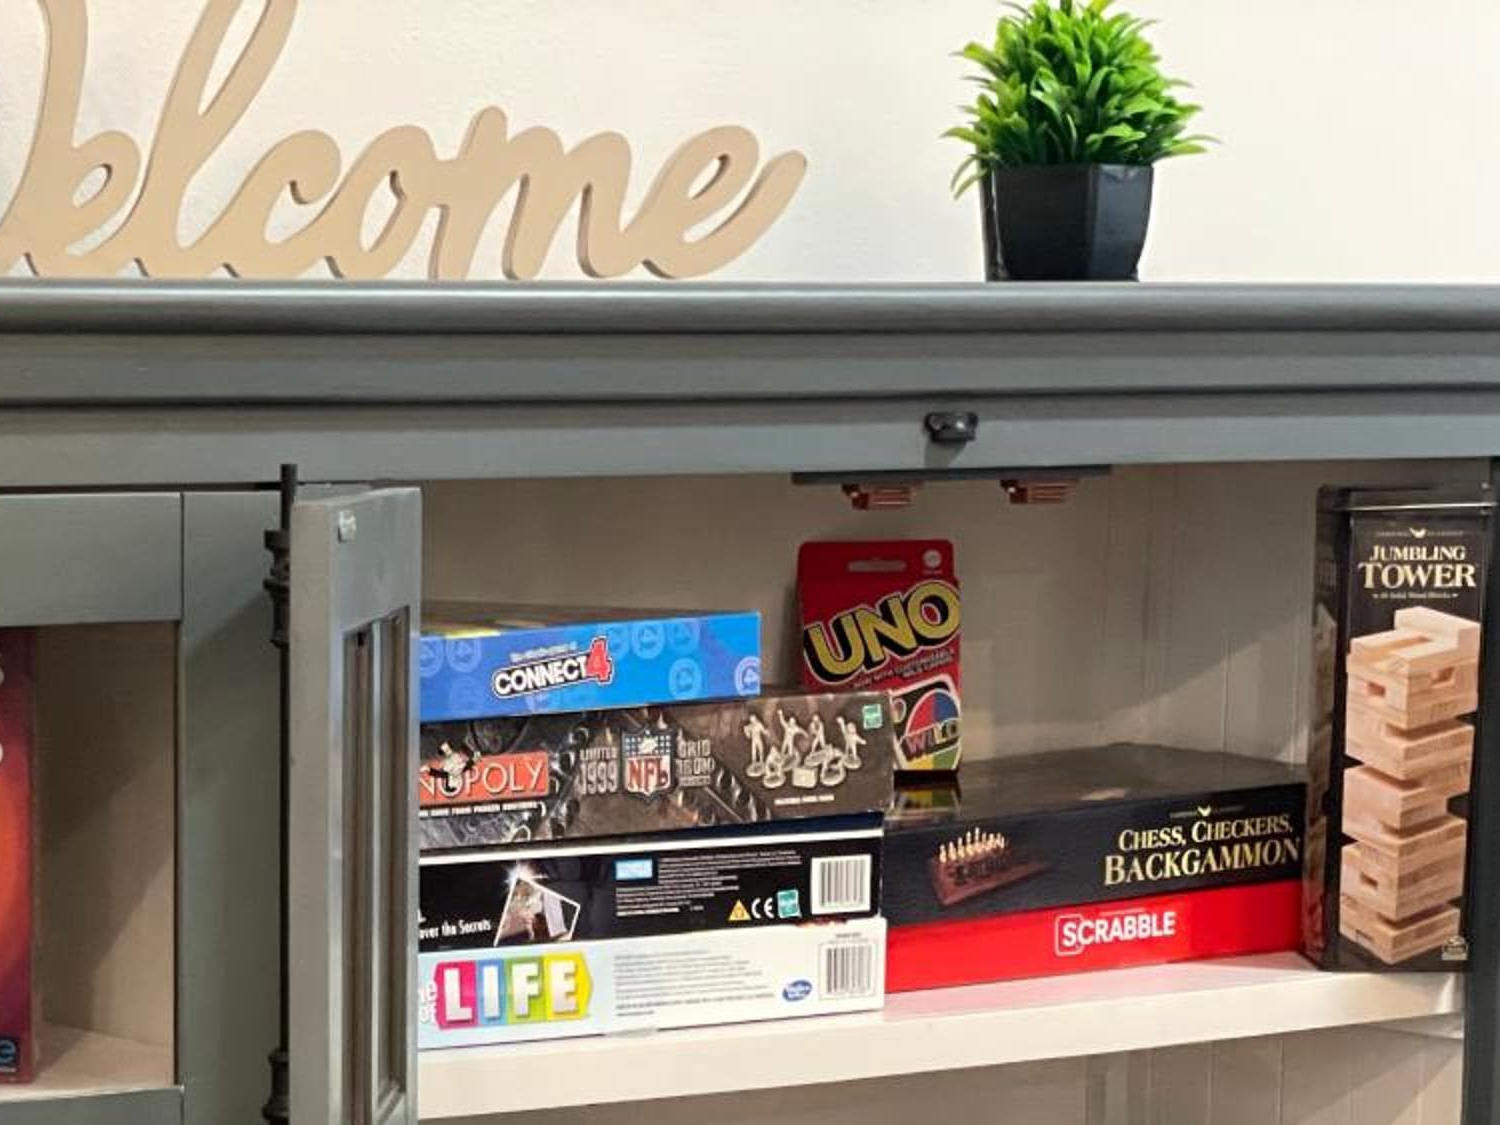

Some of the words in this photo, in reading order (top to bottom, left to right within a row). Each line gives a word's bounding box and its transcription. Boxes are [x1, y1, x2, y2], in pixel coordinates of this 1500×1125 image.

[1369, 545, 1466, 561] JUMBLING
[1358, 562, 1477, 589] TOWER
[804, 580, 961, 682] UNO
[494, 655, 588, 695] CONNECT
[905, 716, 962, 753] WILD
[420, 760, 543, 798] NOPOLY
[627, 756, 669, 793] NFL
[1103, 838, 1300, 886] BACKGAMMON
[1062, 912, 1177, 947] SCRABBLE
[443, 960, 577, 1021] LIFE
